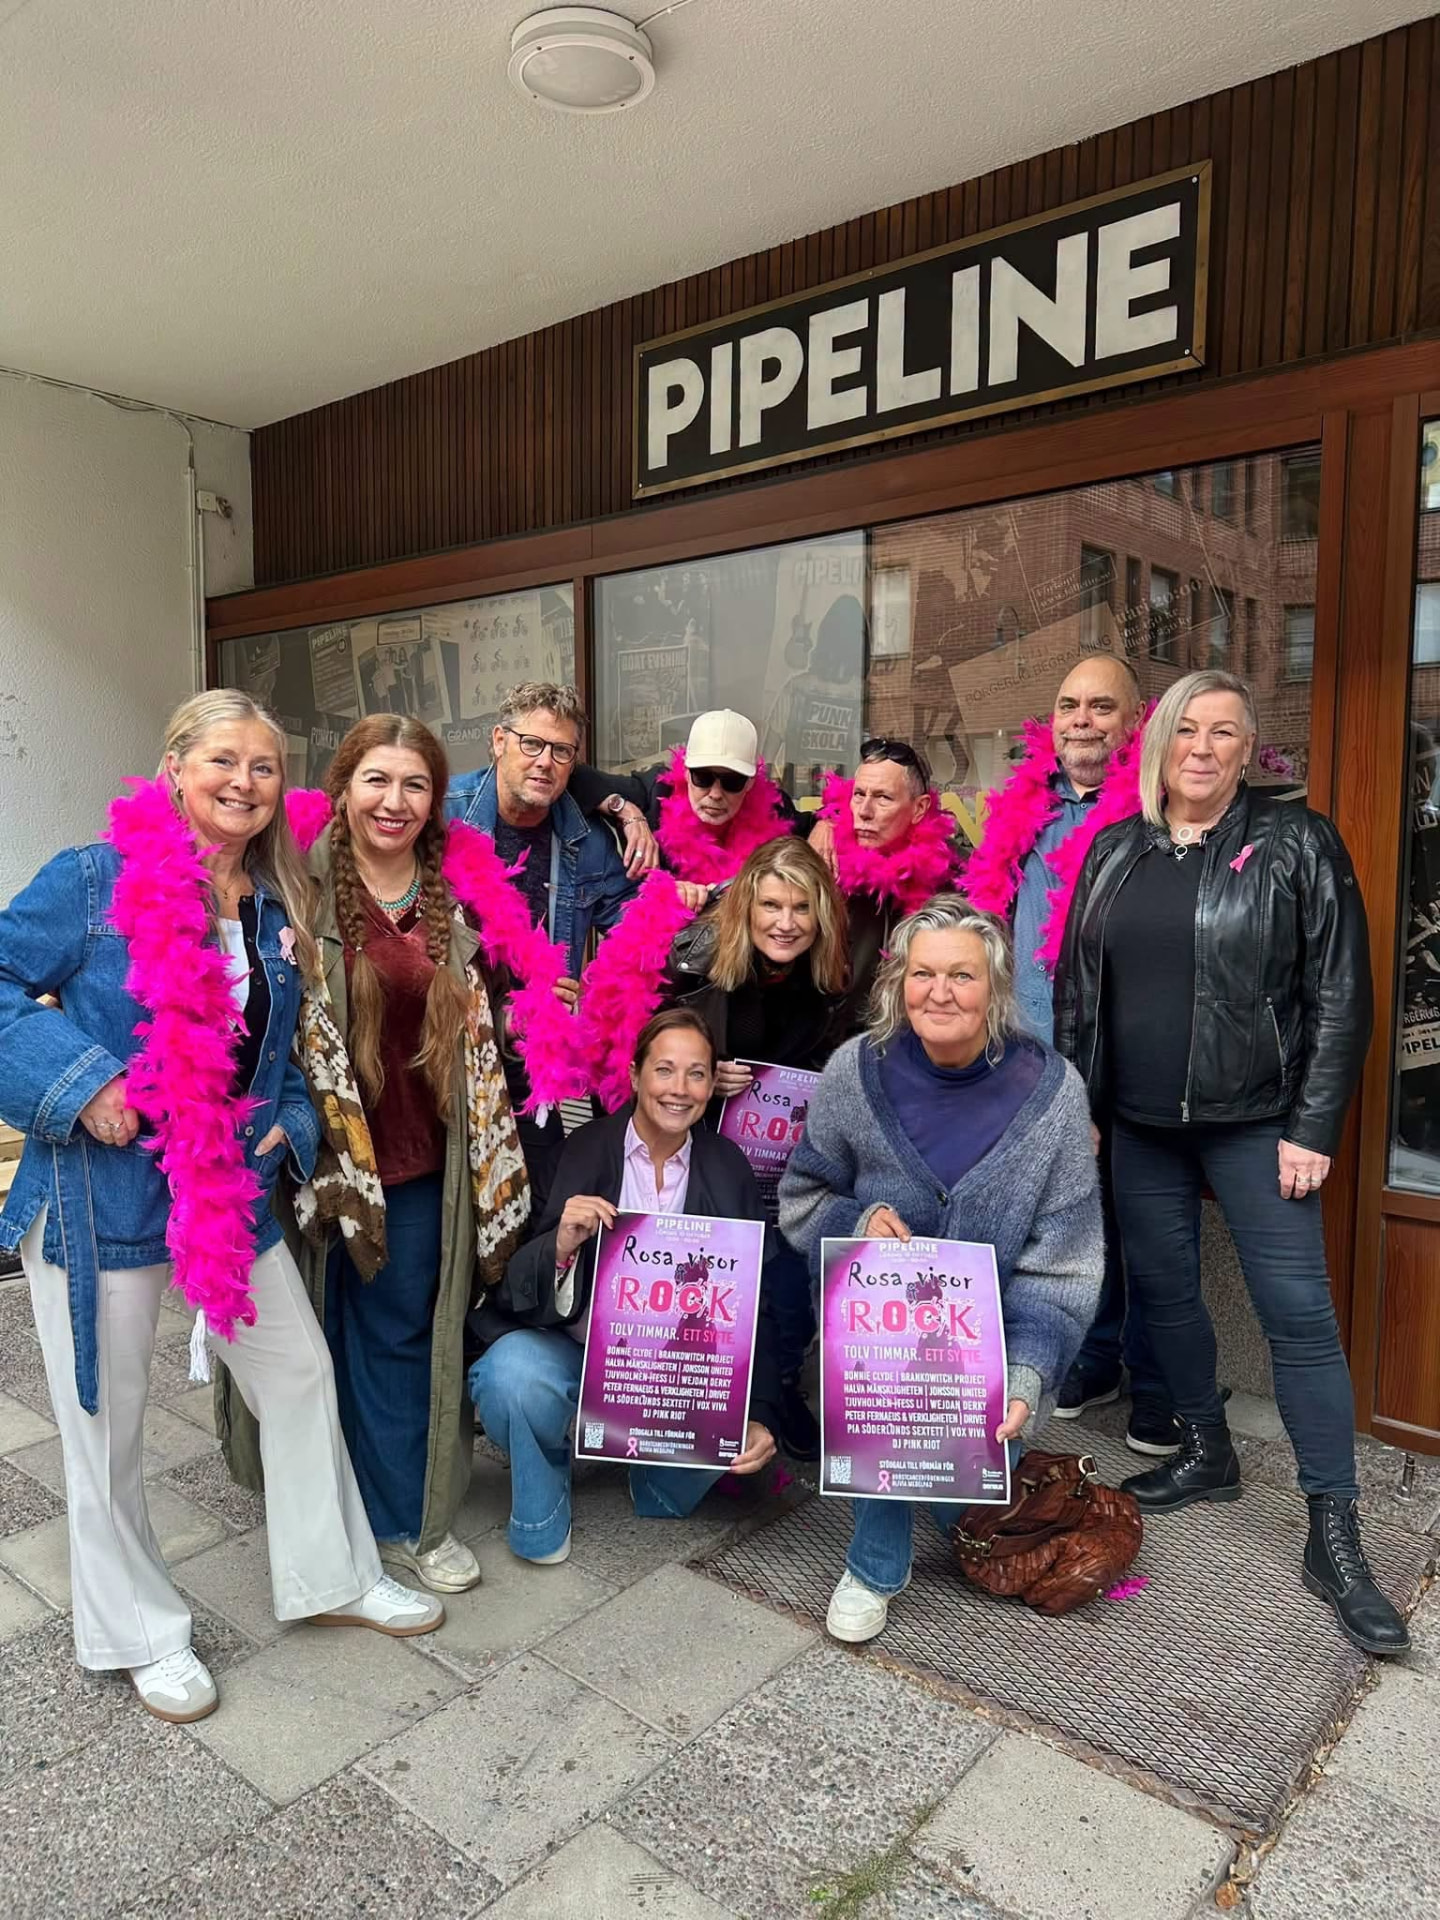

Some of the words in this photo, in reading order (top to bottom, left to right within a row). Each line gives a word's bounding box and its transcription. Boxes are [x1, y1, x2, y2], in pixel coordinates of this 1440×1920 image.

[648, 202, 1181, 470] PIPELINE
[447, 729, 481, 743] GRAND
[1403, 1006, 1440, 1023] RGERLIG
[748, 1080, 791, 1107] Rosa
[656, 1218, 712, 1233] PIPELINE
[622, 1235, 673, 1265] Rosa
[688, 1247, 739, 1271] visor
[879, 1242, 938, 1253] PIPELINE
[848, 1261, 902, 1288] Rosa
[916, 1266, 972, 1290] visor
[616, 1275, 736, 1322] ROCK
[848, 1299, 979, 1341] ROCK
[610, 1322, 634, 1337] TOLV
[637, 1324, 680, 1340] TIMMAR.
[683, 1329, 701, 1342] ETT
[633, 1348, 653, 1358] CLYDE
[706, 1353, 734, 1364] PROJECT
[844, 1345, 870, 1358] TOLV
[873, 1346, 922, 1361] TIMMAR.
[925, 1348, 945, 1361] ETT
[872, 1371, 894, 1382] CLYDE
[954, 1374, 986, 1384] PROJECT
[603, 1382, 622, 1392] PETER
[603, 1394, 615, 1403] PIA
[661, 1398, 691, 1409] SEXTETT
[696, 1400, 710, 1410] VOX
[711, 1402, 728, 1412] VIVA
[643, 1408, 652, 1418] DJ
[653, 1409, 669, 1419] PINK
[670, 1411, 686, 1421] RIOT
[845, 1411, 865, 1420] PETER
[847, 1424, 860, 1434] PIA
[912, 1426, 944, 1437] SEXTETT
[951, 1427, 966, 1437] VOX
[968, 1428, 986, 1438] VIVA
[892, 1439, 902, 1449] DJ
[903, 1440, 921, 1449] PINK
[923, 1440, 941, 1450] RIOT
